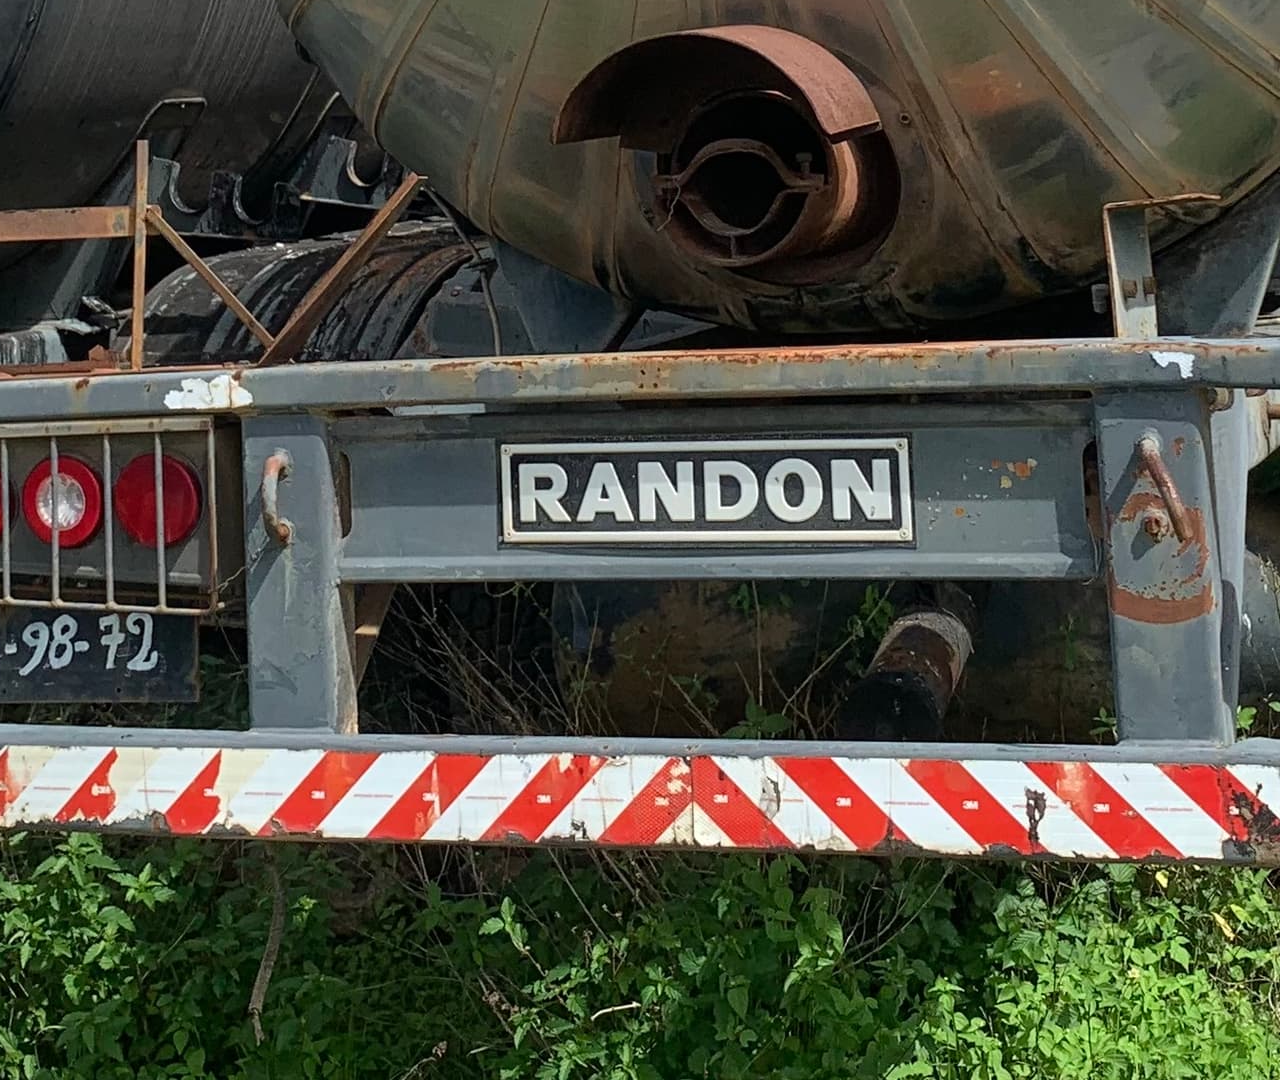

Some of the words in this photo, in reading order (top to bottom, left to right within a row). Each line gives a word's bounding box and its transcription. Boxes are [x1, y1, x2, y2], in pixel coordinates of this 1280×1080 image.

[518, 458, 893, 523] RANDON
[536, 794, 551, 804] 3M
[713, 793, 728, 804] 3M
[835, 797, 851, 807] 3M
[962, 800, 978, 810] 3M
[1093, 803, 1110, 813] 3M
